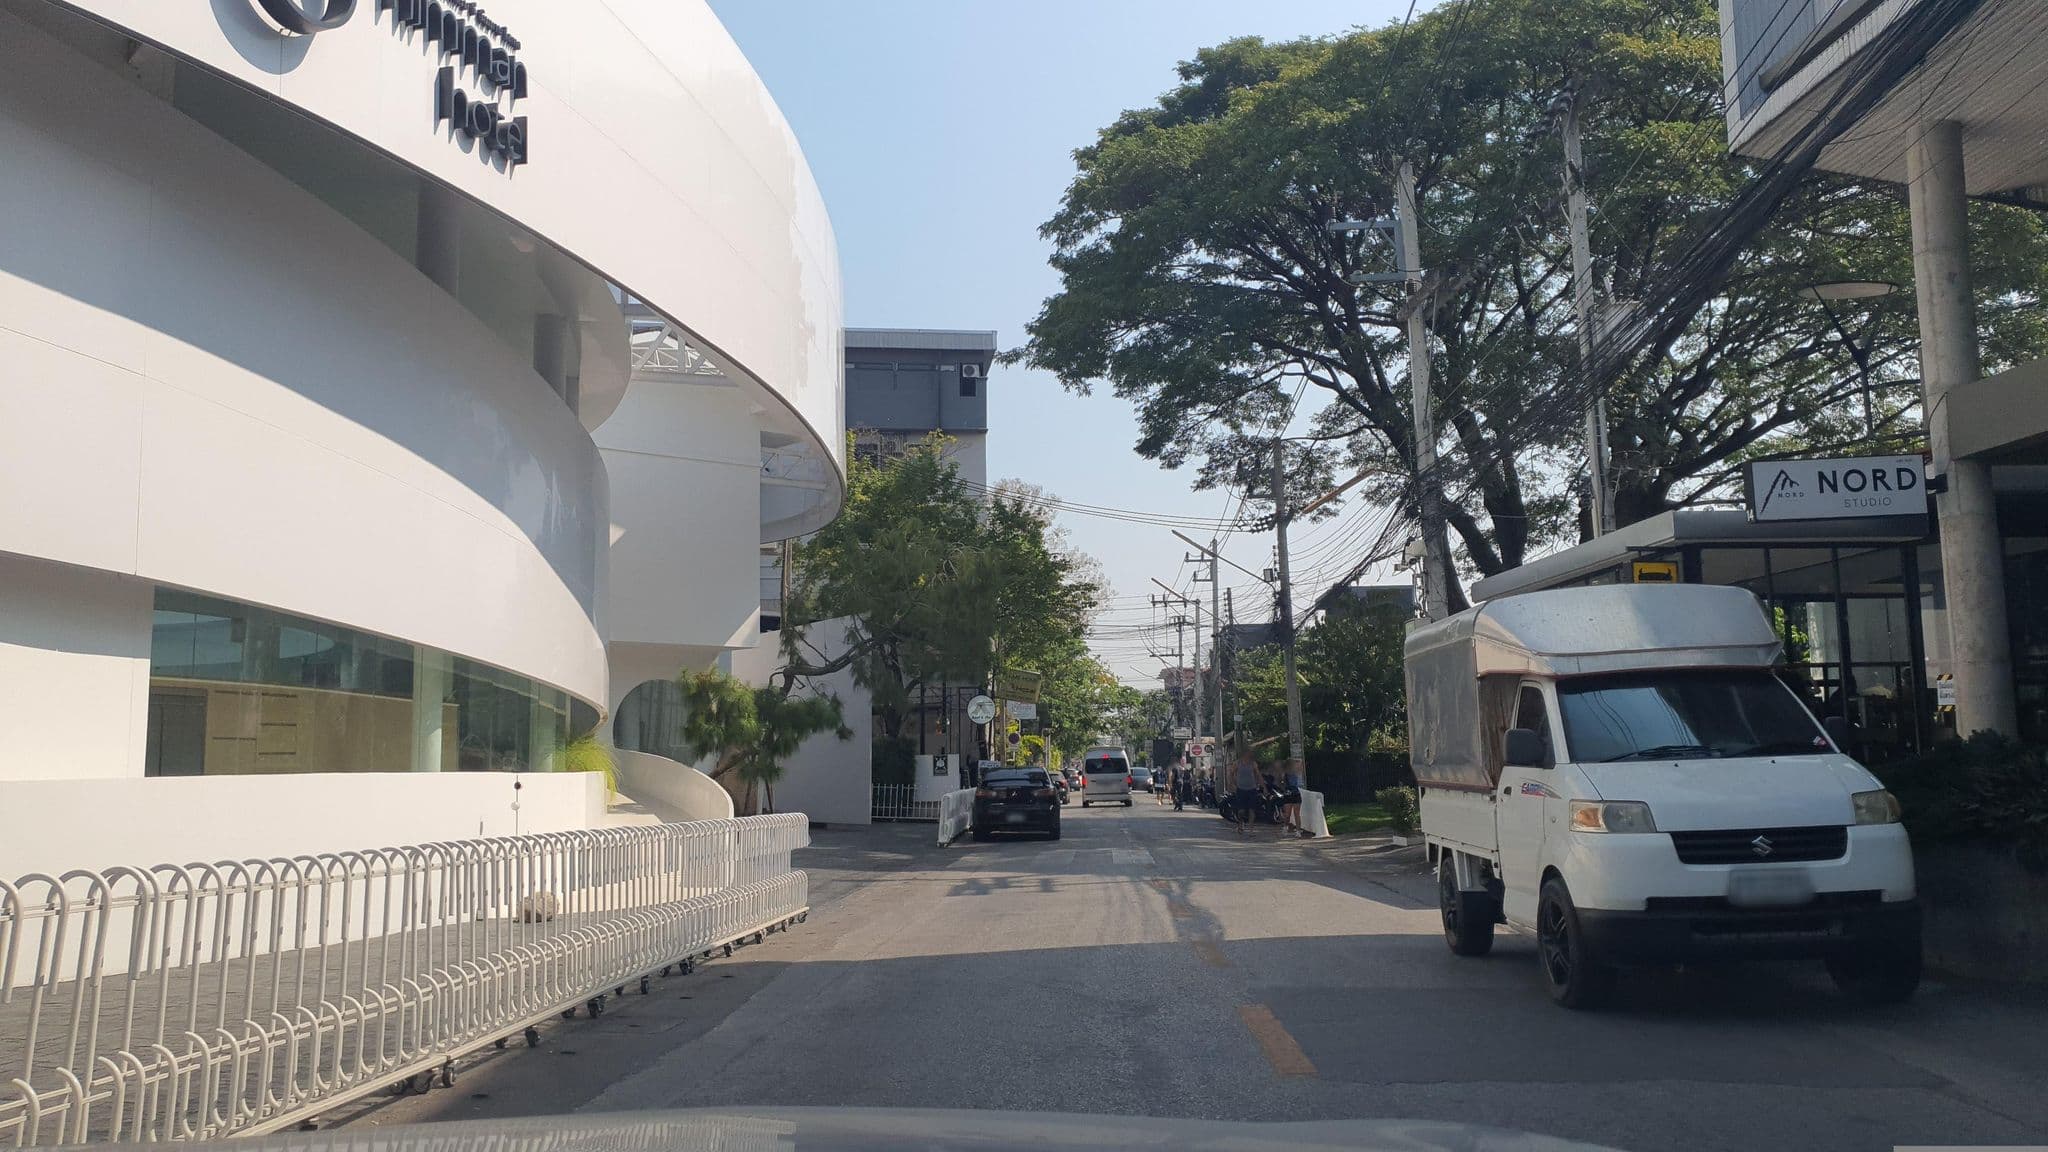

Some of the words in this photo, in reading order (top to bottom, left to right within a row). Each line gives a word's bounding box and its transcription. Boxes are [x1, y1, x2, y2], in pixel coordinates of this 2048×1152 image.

[438, 66, 528, 165] hotel
[1817, 467, 1917, 494] NORD
[1843, 496, 1892, 508] STUDIO
